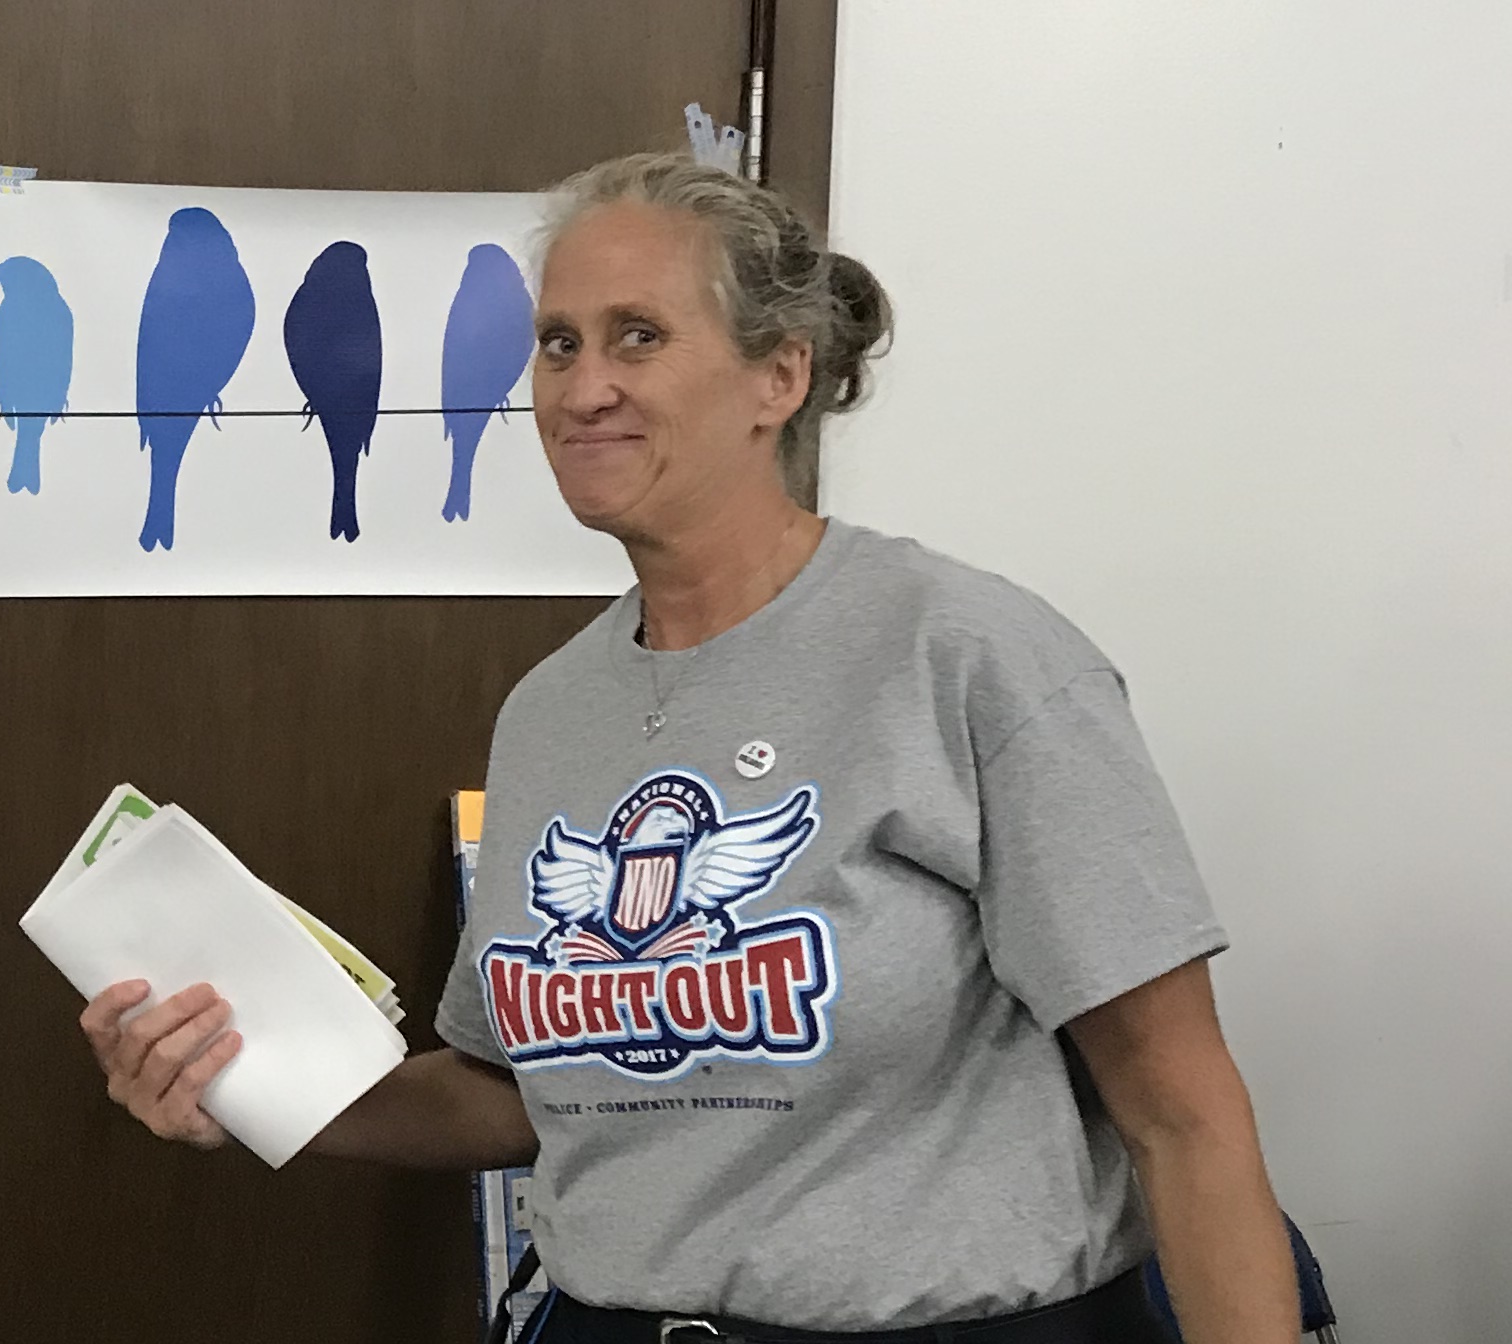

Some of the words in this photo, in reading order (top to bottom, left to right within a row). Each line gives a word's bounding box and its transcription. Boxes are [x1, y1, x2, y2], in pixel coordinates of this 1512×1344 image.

[617, 781, 704, 822] NATIONAL
[614, 855, 676, 932] NNO
[489, 958, 659, 1049] NIGHT
[665, 936, 808, 1037] OUT
[626, 1049, 667, 1063] 2017
[597, 1098, 685, 1114] COMMUNITY
